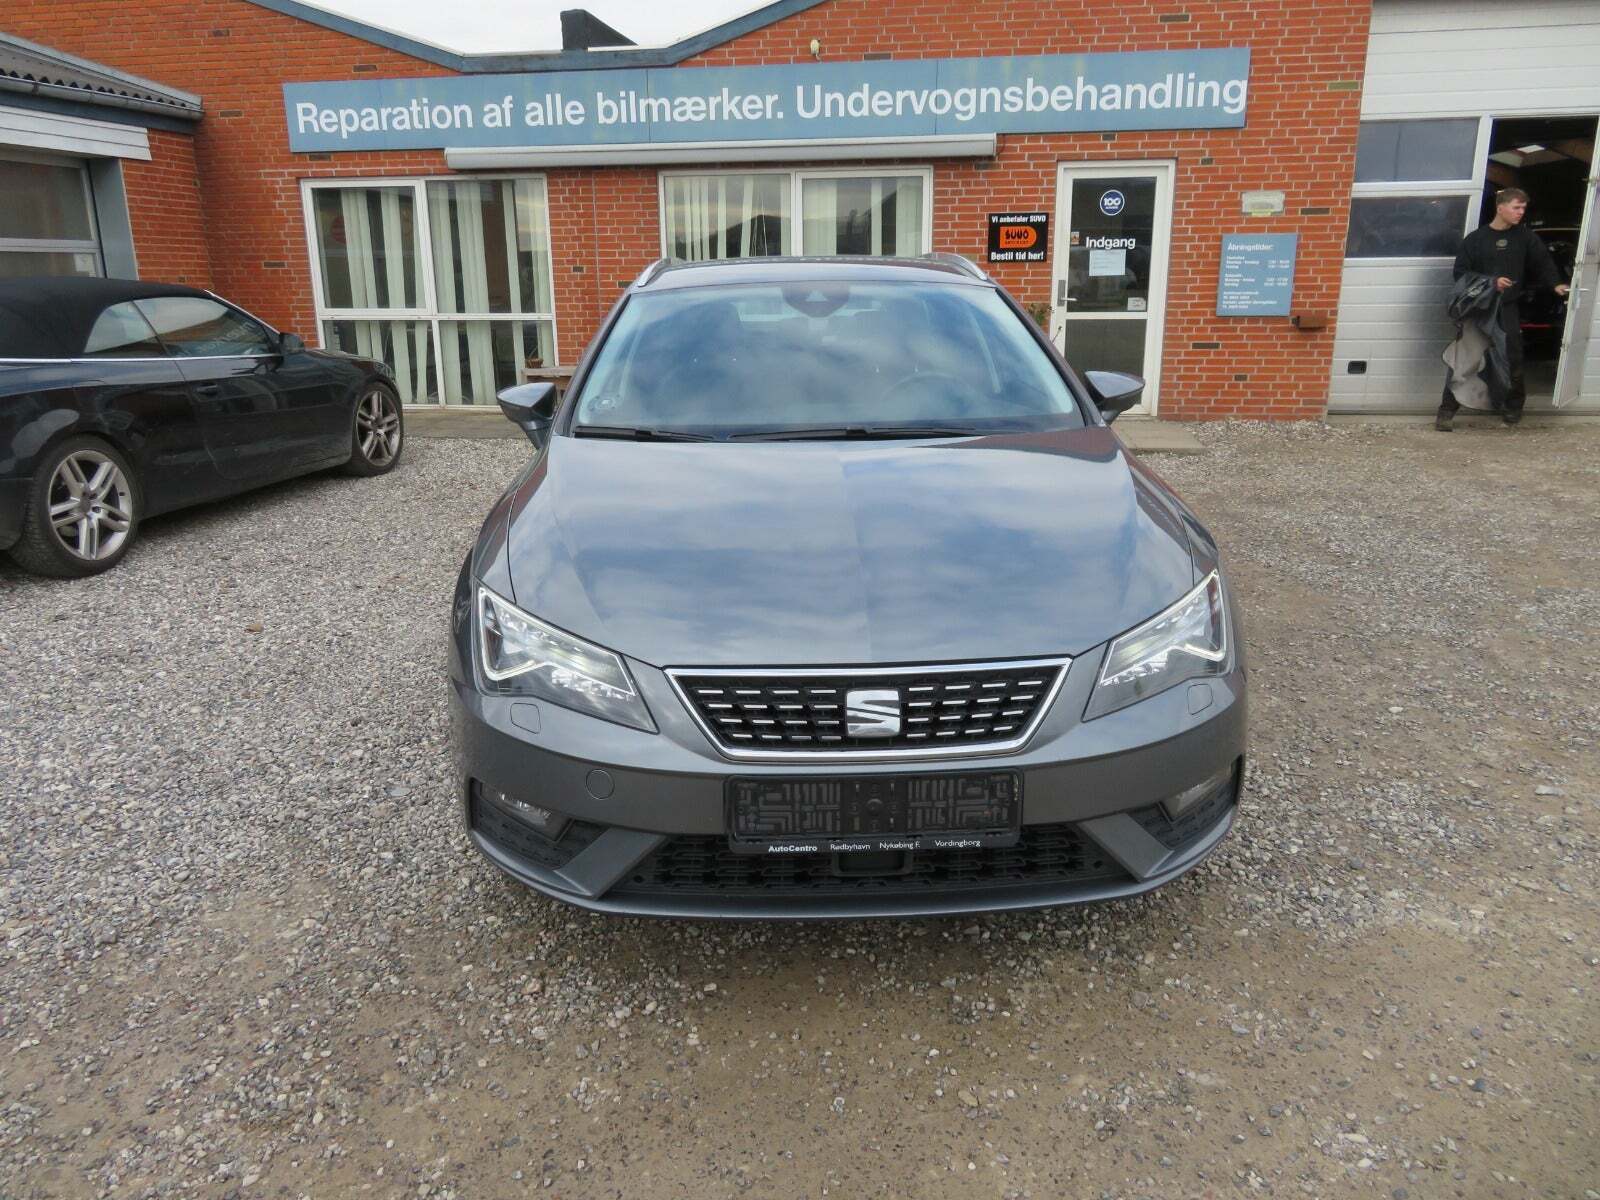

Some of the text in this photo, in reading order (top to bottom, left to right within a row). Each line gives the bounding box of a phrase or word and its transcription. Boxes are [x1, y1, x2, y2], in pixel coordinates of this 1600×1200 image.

[296, 72, 1248, 139] Reparation af alle bilmærker. Undervognsbehandling
[991, 215, 998, 223] Vi
[1029, 215, 1046, 223] SUVO
[1085, 236, 1136, 250] Indgang
[990, 251, 1044, 261] Bestil tid her!
[934, 839, 981, 848] Vordingborg
